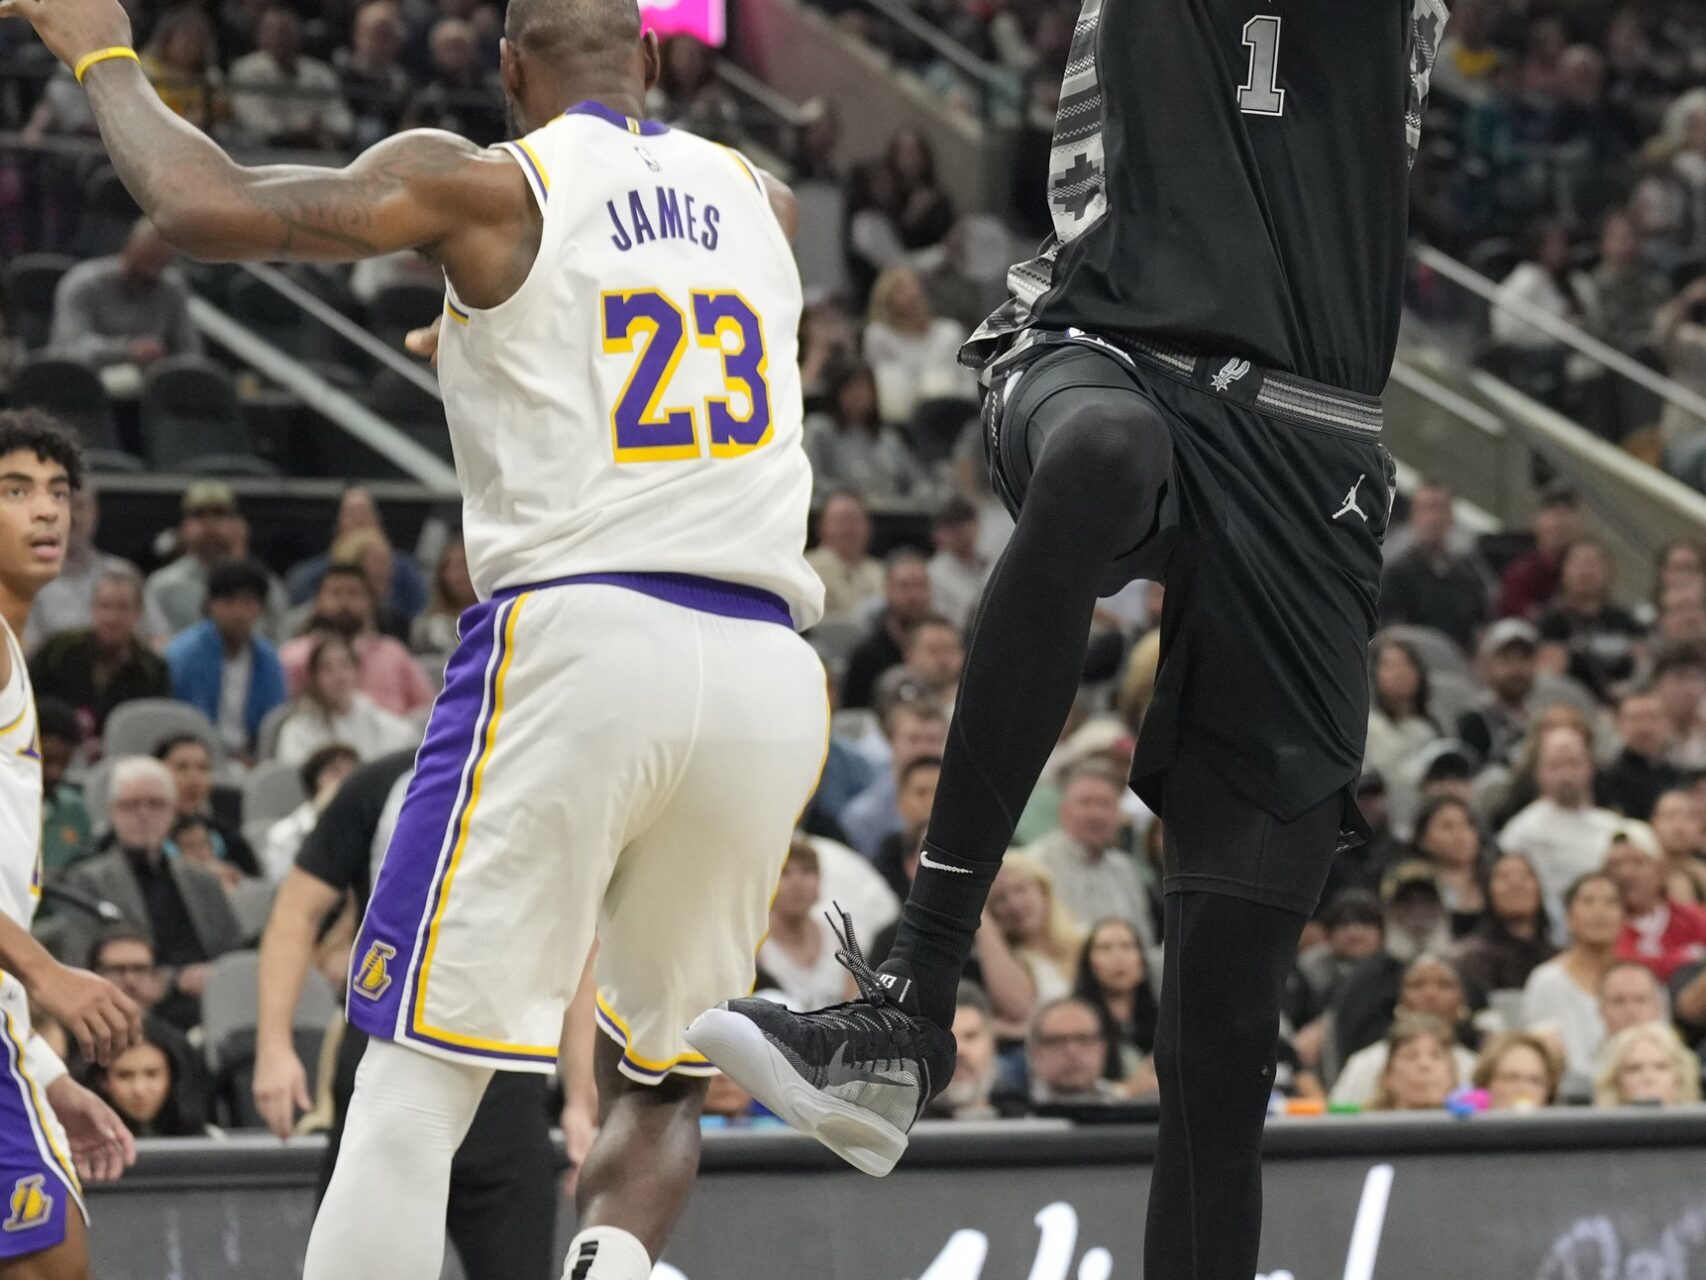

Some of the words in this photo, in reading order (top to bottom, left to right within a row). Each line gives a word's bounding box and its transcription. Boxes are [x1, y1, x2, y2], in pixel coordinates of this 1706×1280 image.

[1236, 14, 1285, 116] 1
[606, 186, 721, 252] JAMES
[601, 287, 775, 464] 23
